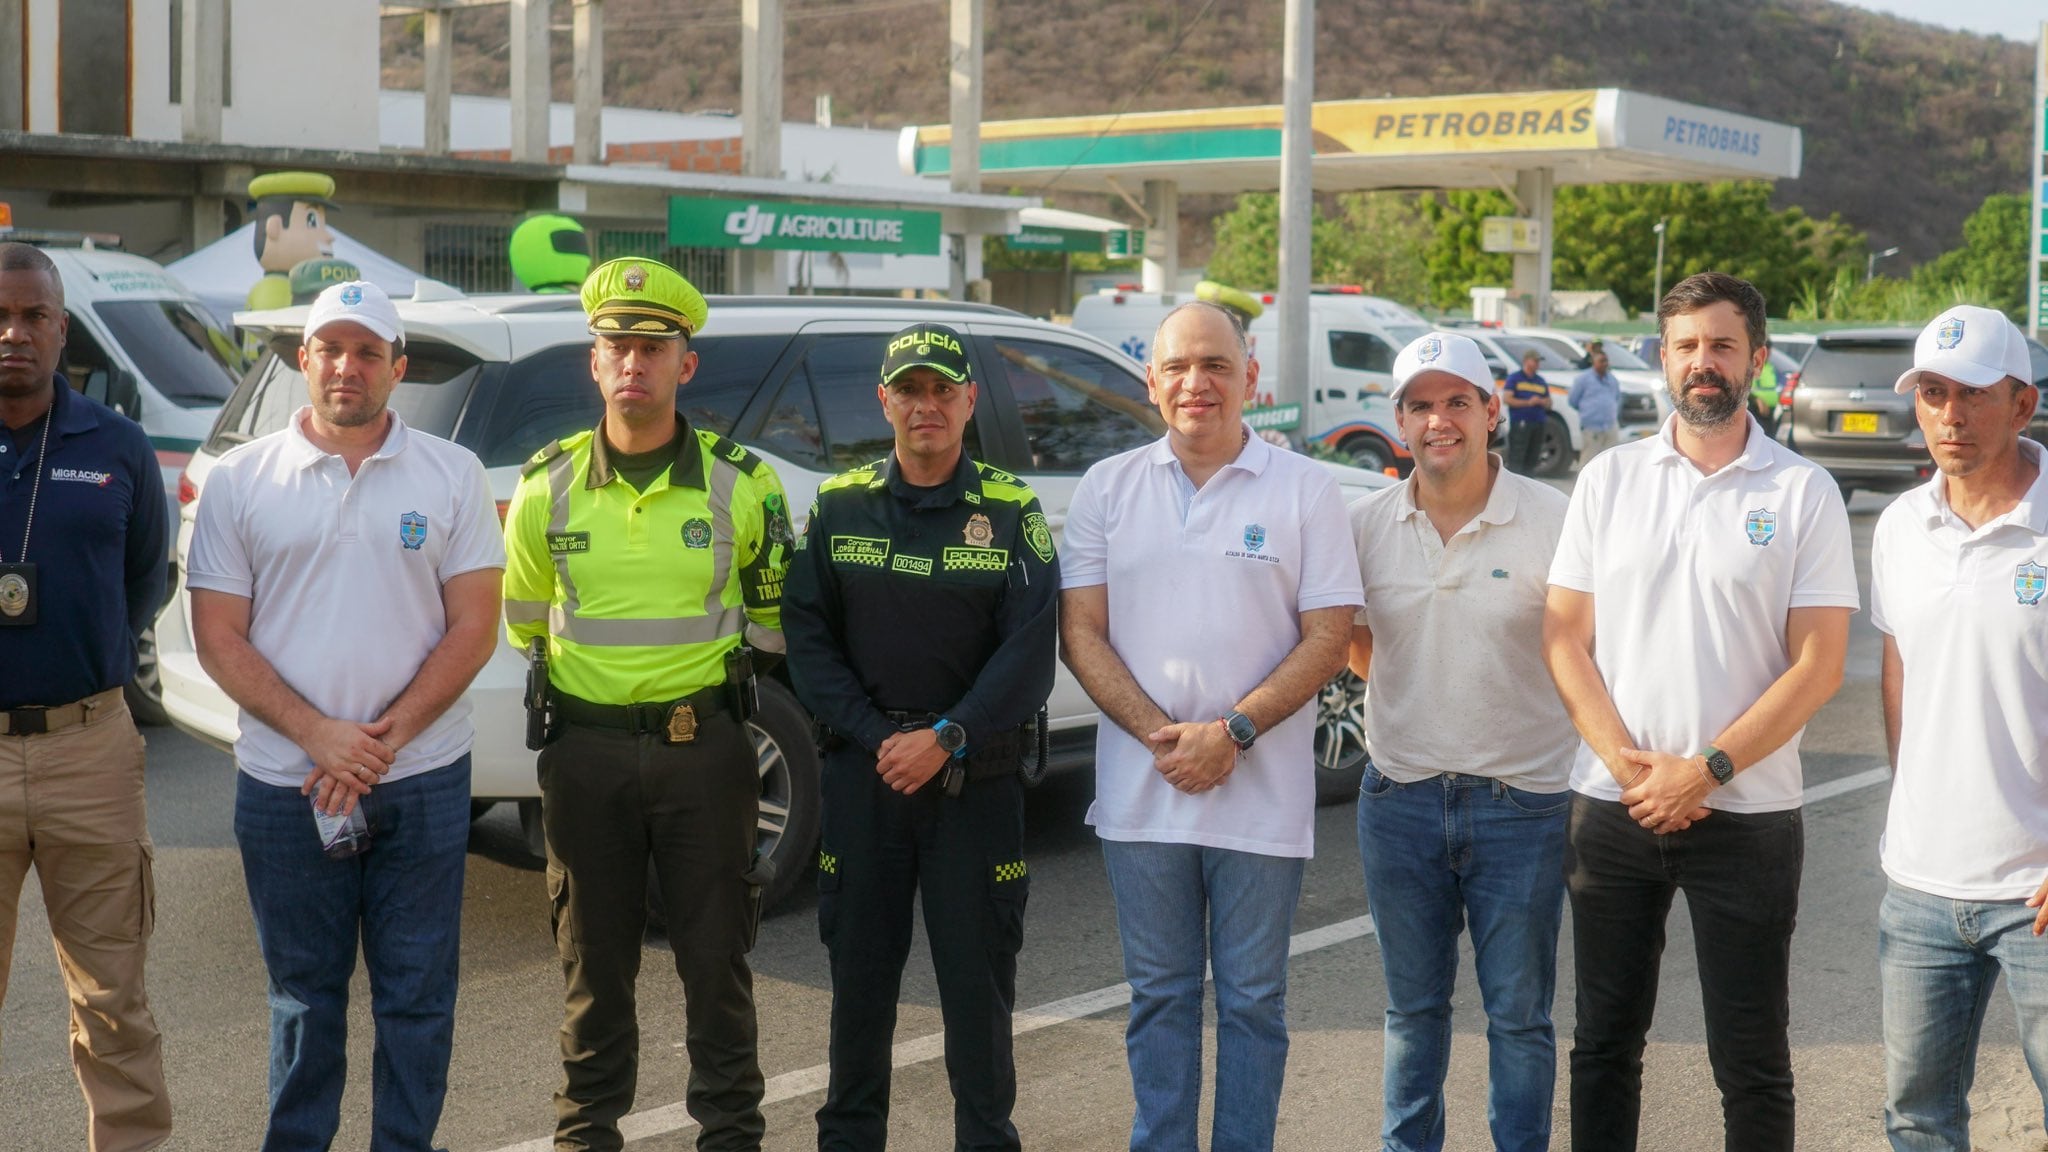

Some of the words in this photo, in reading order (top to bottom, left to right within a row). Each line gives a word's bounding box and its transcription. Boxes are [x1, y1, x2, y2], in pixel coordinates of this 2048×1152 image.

[1373, 106, 1593, 139] PETROBRAS
[1663, 115, 1761, 157] PETROBRAS
[777, 214, 904, 242] AGRICULTURE
[888, 331, 963, 357] POLICÍA
[51, 467, 107, 483] MIGRACIÓN
[568, 541, 587, 550] ORTIZ
[835, 545, 857, 553] JORGE
[856, 546, 884, 555] BERNAL
[895, 557, 929, 572] 001494
[950, 551, 1001, 563] POLICÍA
